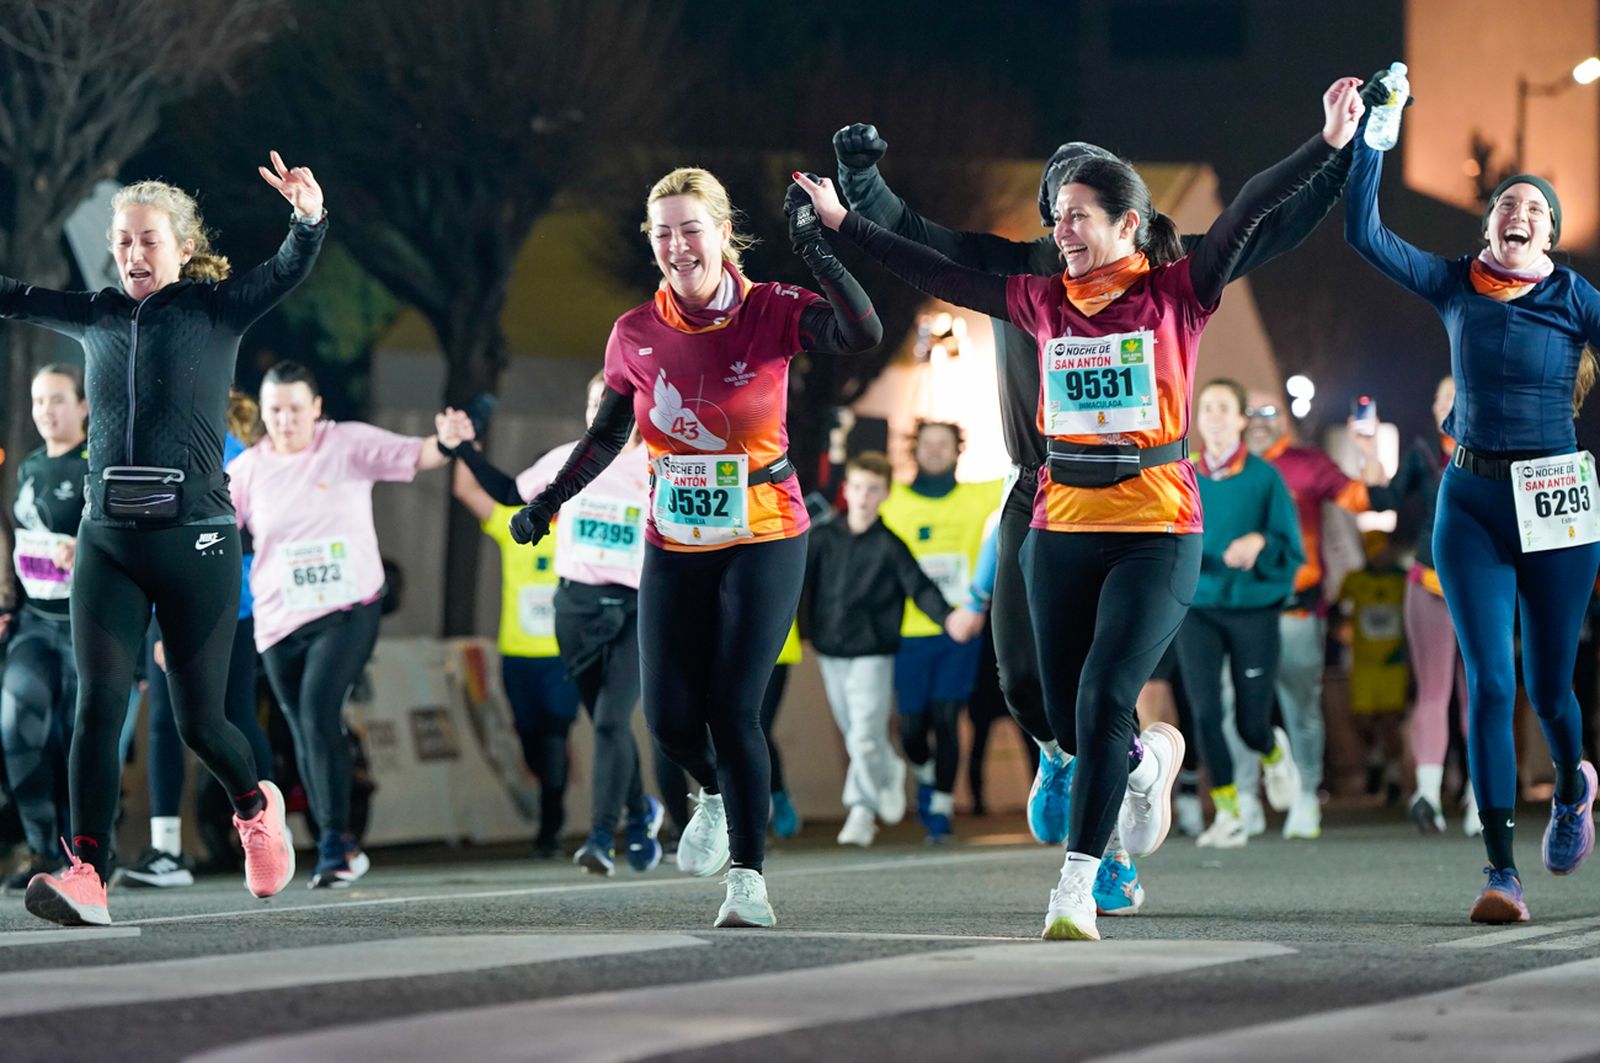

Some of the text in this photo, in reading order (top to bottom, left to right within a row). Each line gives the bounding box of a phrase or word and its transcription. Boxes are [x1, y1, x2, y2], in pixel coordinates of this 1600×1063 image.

[1066, 346, 1097, 356] NOCHE
[1098, 344, 1111, 354] DE
[1055, 358, 1075, 370] SAN
[1077, 354, 1111, 368] ANTÓN
[1065, 367, 1134, 400] 9531
[1079, 400, 1123, 410] INMACULADA
[671, 416, 699, 440] 43
[670, 465, 691, 475] OCHE
[694, 465, 707, 475] DE
[1535, 466, 1565, 477] NOCHE
[1566, 464, 1576, 474] DE
[673, 475, 707, 487] ANTÓN
[1525, 474, 1577, 491] SAN ANTÓN
[1534, 485, 1590, 518] 6293
[199, 532, 219, 542] NIKE
[579, 519, 634, 545] 12395
[293, 563, 341, 586] 6623
